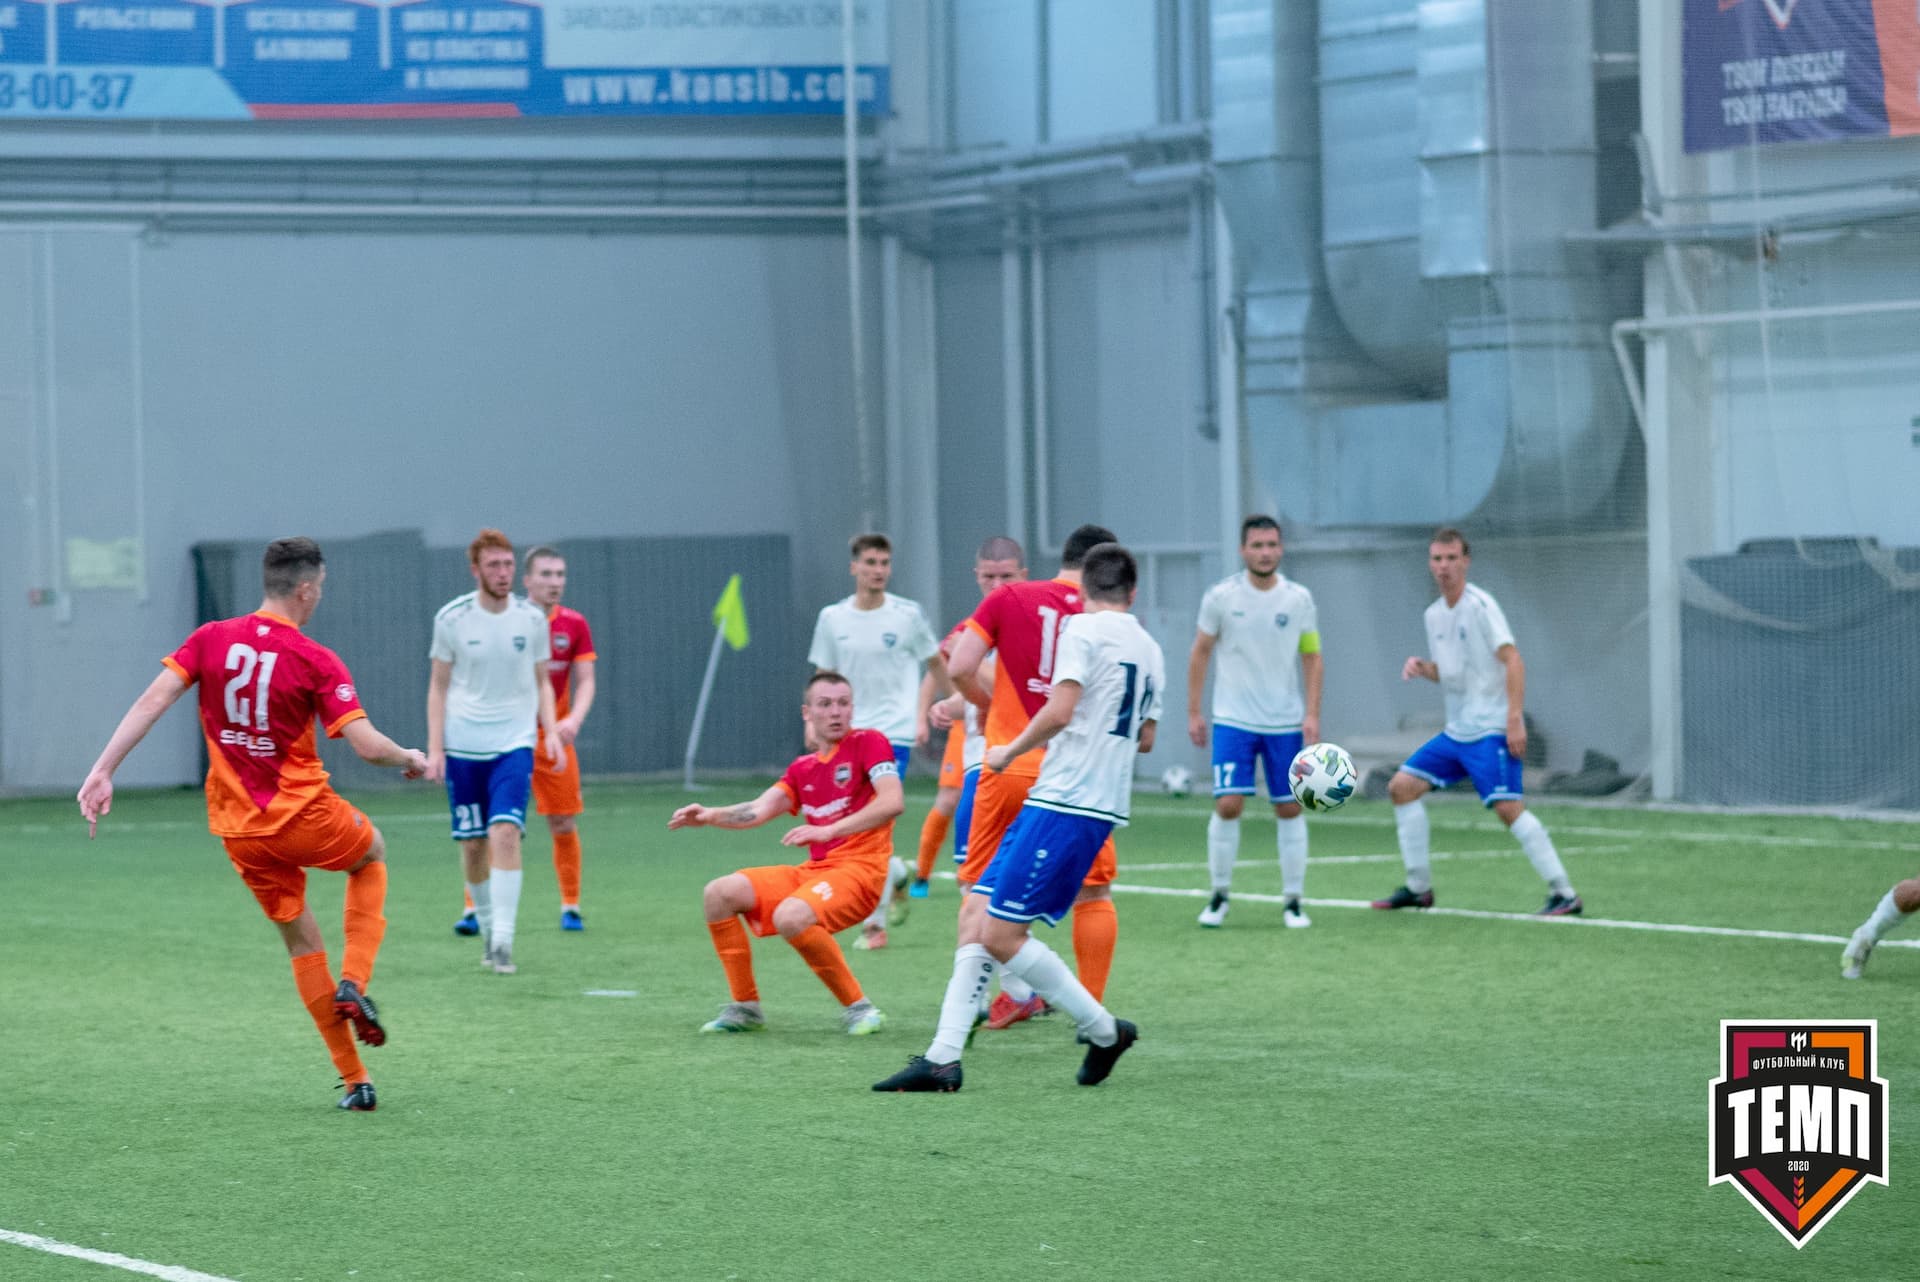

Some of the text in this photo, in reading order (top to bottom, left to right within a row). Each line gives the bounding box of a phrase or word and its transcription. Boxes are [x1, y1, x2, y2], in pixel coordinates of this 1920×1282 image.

[224, 642, 278, 731] 21
[220, 729, 276, 751] SELS
[1214, 763, 1236, 787] 17
[456, 804, 482, 830] 21
